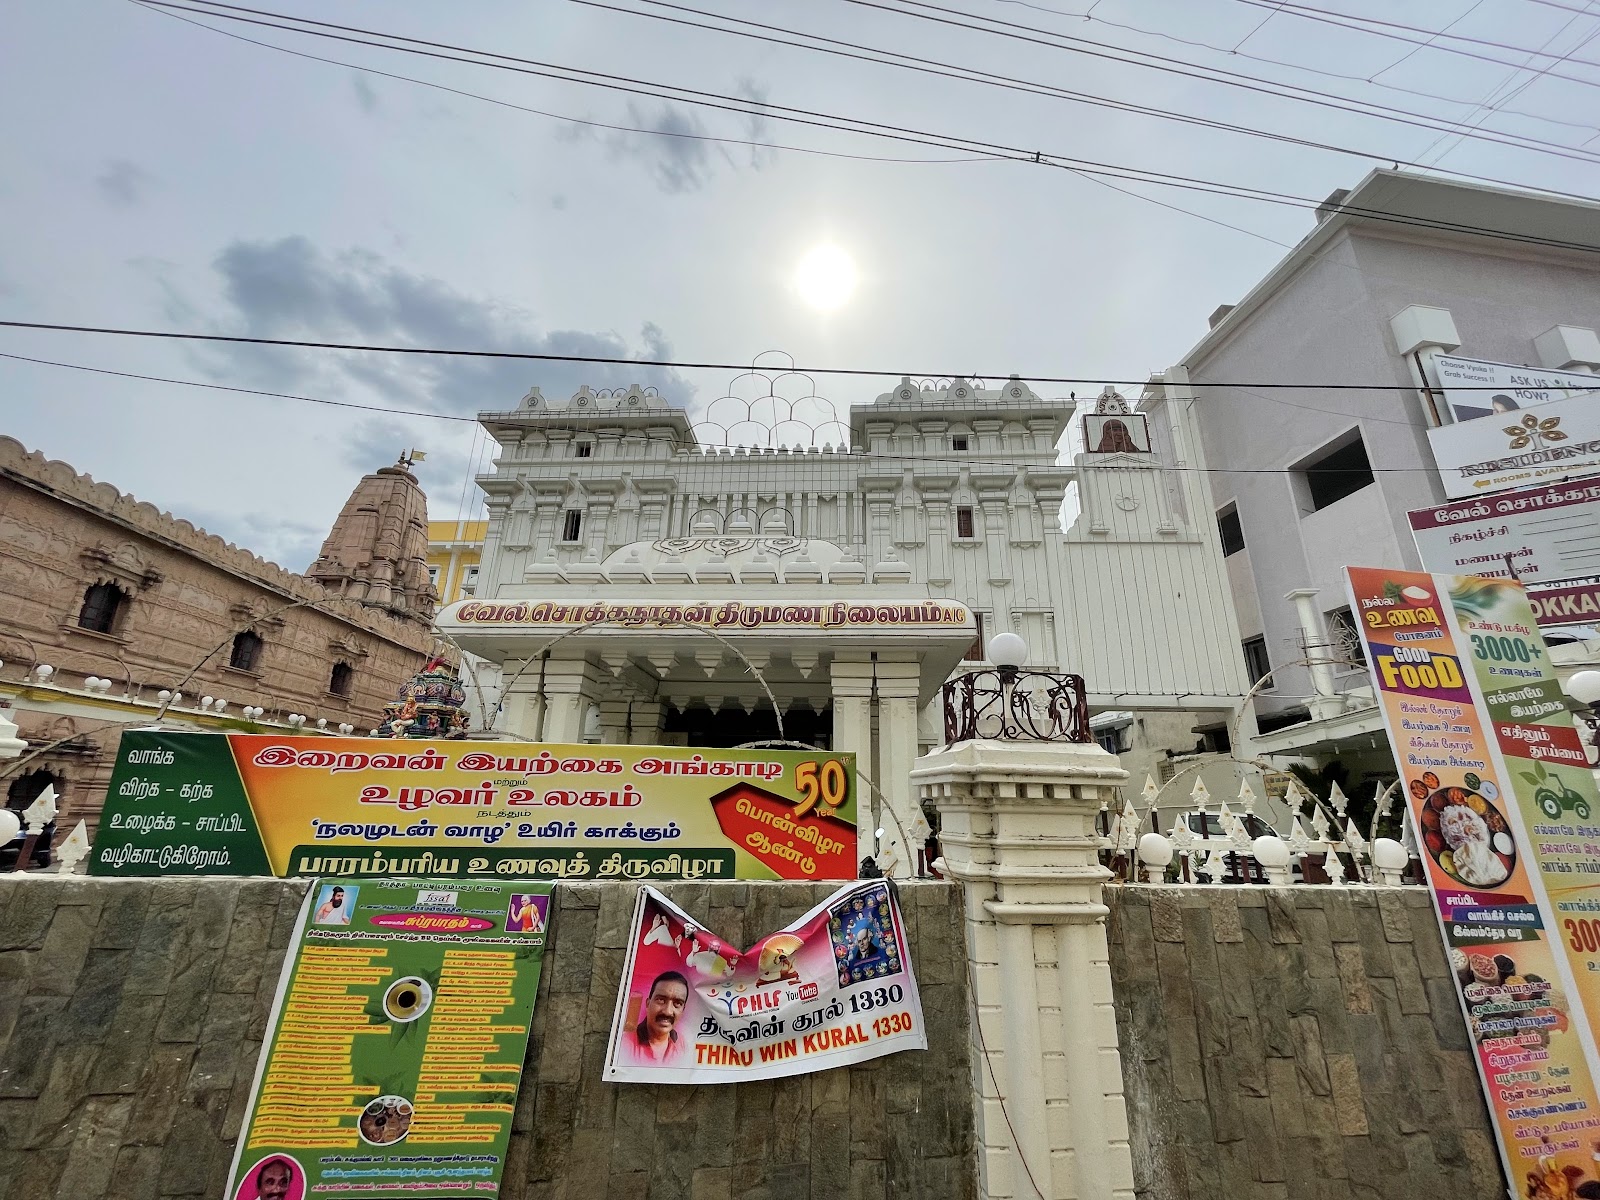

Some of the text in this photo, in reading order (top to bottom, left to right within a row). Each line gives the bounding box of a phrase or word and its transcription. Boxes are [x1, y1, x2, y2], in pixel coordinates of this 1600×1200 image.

[1463, 373, 1488, 382] Success
[1511, 376, 1549, 389] ASK US
[1515, 388, 1549, 401] HOW?
[1494, 472, 1531, 485] ROOMS
[1434, 502, 1491, 523] வேல்
[1449, 526, 1509, 545] நிகழ்ச்சி
[1455, 546, 1533, 566] மணமகன்
[1362, 595, 1394, 609] நல்ல
[1366, 607, 1441, 628] உணவு
[1470, 620, 1502, 633] உண்டு
[1393, 647, 1431, 662] GOOD
[1471, 634, 1541, 663] 3000+
[1489, 667, 1542, 678] உணவுகள்
[1488, 686, 1544, 705] எல்லாமே
[1400, 702, 1462, 719] இல்லம் தோறும்
[1510, 700, 1565, 718] இயற்கை
[1402, 719, 1471, 734] இயற்கை உணவு
[1501, 725, 1549, 741] எதிலும்
[1441, 738, 1474, 753] தோறும்
[1529, 744, 1584, 760] தூய்மை
[128, 746, 174, 767] வாங்க
[253, 746, 782, 781] இறைவன் இயற்கை அங்காடி
[1408, 753, 1484, 770] இயற்கை அங்காடி
[119, 776, 160, 801] விற்க
[179, 779, 213, 802] கற்க
[494, 777, 528, 787] மற்றும்
[360, 782, 642, 809] உழவர் உலகம்
[476, 809, 532, 819] நடத்தும்
[813, 806, 837, 818] Year
[110, 809, 176, 835] உழைக்க
[195, 813, 247, 833] சாப்பிட
[735, 798, 845, 856] பொன்விழா
[1534, 823, 1574, 835] எல்லாமே
[517, 821, 578, 840] உயிர்
[583, 822, 681, 842] காக்கும்
[100, 843, 232, 870] வழிகாட்டுகிறோம்.
[745, 831, 817, 875] ஆண்டு
[1538, 841, 1581, 856] நல்லாவே
[299, 848, 724, 878] பாரம்பரிய உணவுத் திருவிழா
[1446, 894, 1479, 905] சாப்பிட
[404, 915, 470, 929] சுப்ரபாதம்
[1506, 910, 1535, 921] செல்ல
[1507, 929, 1522, 940] வர
[792, 998, 844, 1033] குரல்
[849, 984, 904, 1014] 1330
[760, 1039, 798, 1064] WIN
[803, 1025, 869, 1055] KURAL
[872, 1012, 912, 1039] 1330
[1547, 1063, 1570, 1077] தேன்
[1500, 1087, 1524, 1103] தேன்
